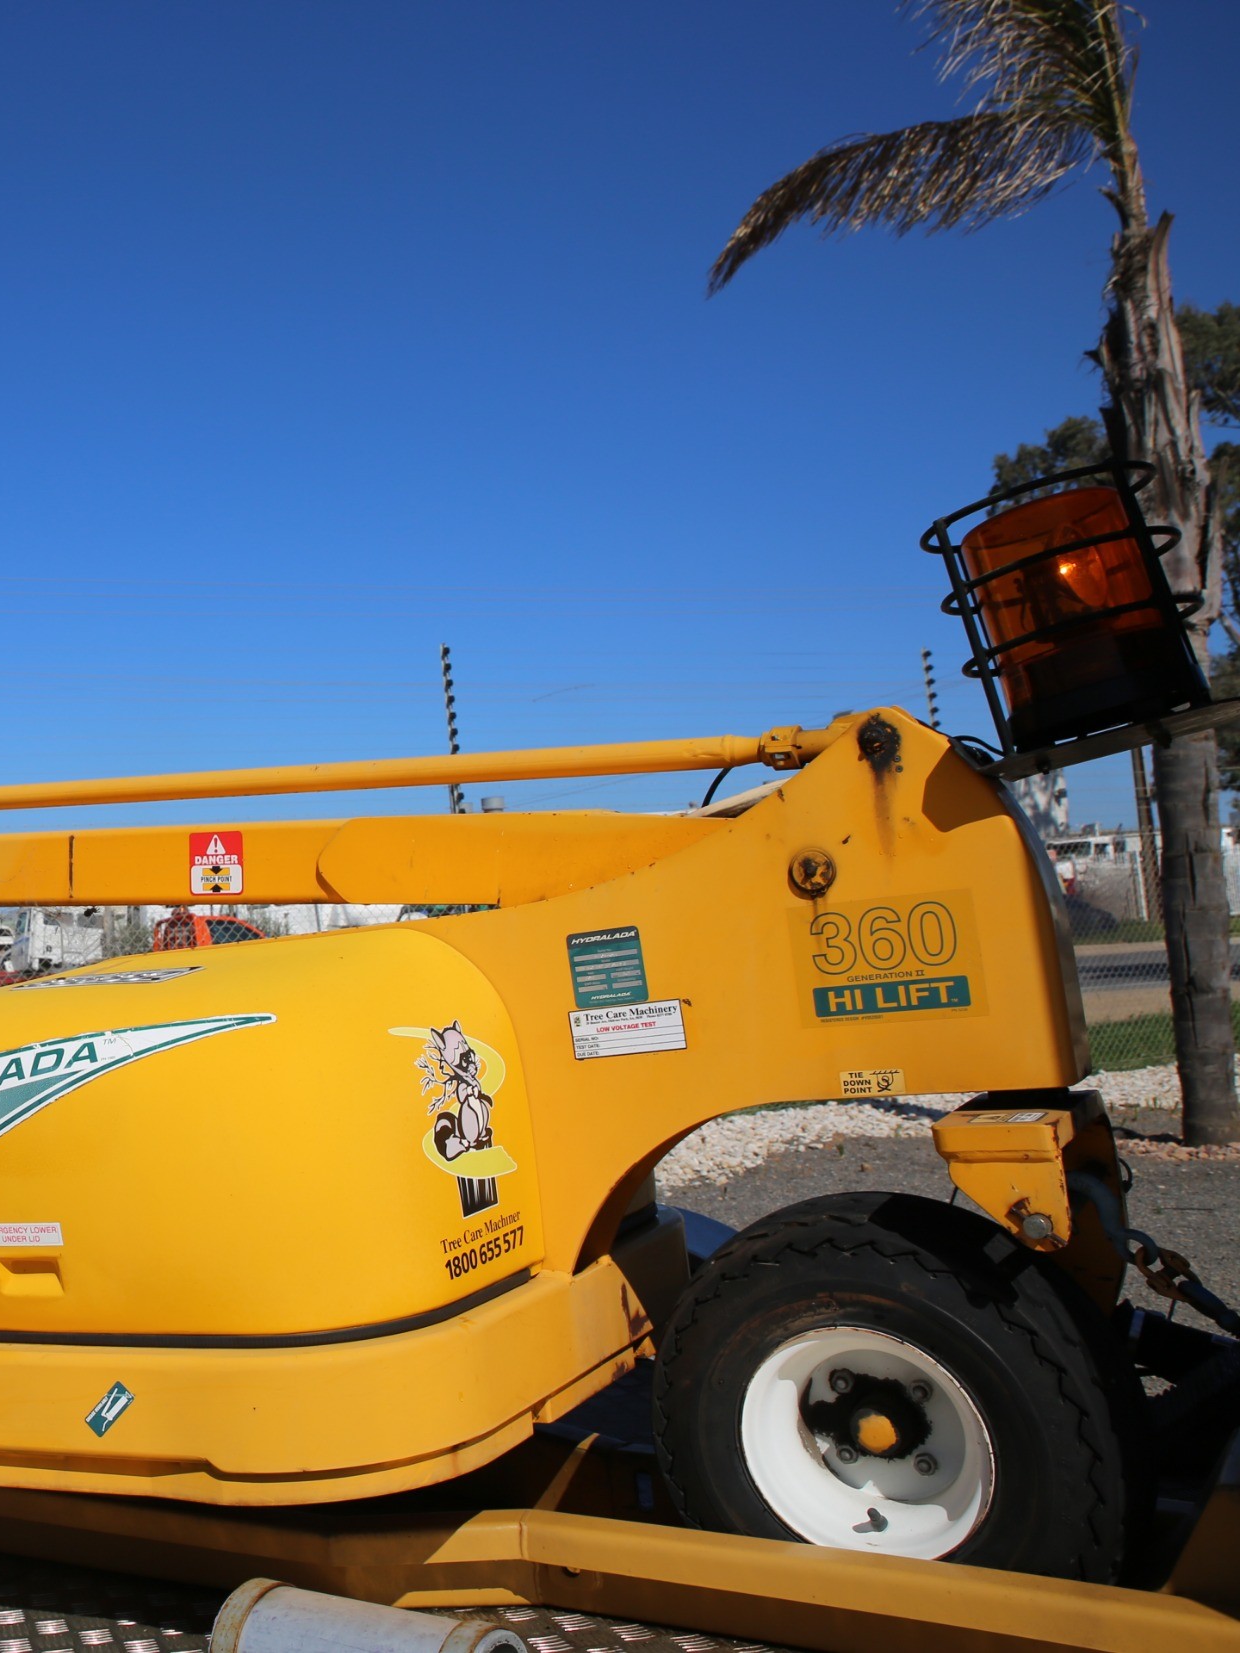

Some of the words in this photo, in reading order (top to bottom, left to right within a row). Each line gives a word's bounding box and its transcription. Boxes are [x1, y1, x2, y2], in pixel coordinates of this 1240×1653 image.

[194, 854, 239, 865] DANGER
[571, 931, 635, 945] HYDRALADA
[810, 901, 957, 975] 360
[847, 971, 913, 983] GENERATION
[827, 989, 864, 1012] HI
[875, 981, 955, 1009] LIFT
[583, 1012, 604, 1022] Tree
[605, 1010, 627, 1019] Care
[629, 1005, 678, 1018] Machinery
[611, 1023, 640, 1031] VOLTAGE
[843, 1079, 872, 1087] DOWN
[843, 1086, 872, 1095] POINT
[29, 1226, 57, 1234] LOWER
[2, 1235, 27, 1243] UNDER
[29, 1235, 41, 1243] LID
[440, 1238, 462, 1254] Tree
[463, 1228, 483, 1244] Care
[445, 1248, 478, 1280] 1800
[479, 1236, 502, 1265] 655
[502, 1225, 524, 1253] 577
